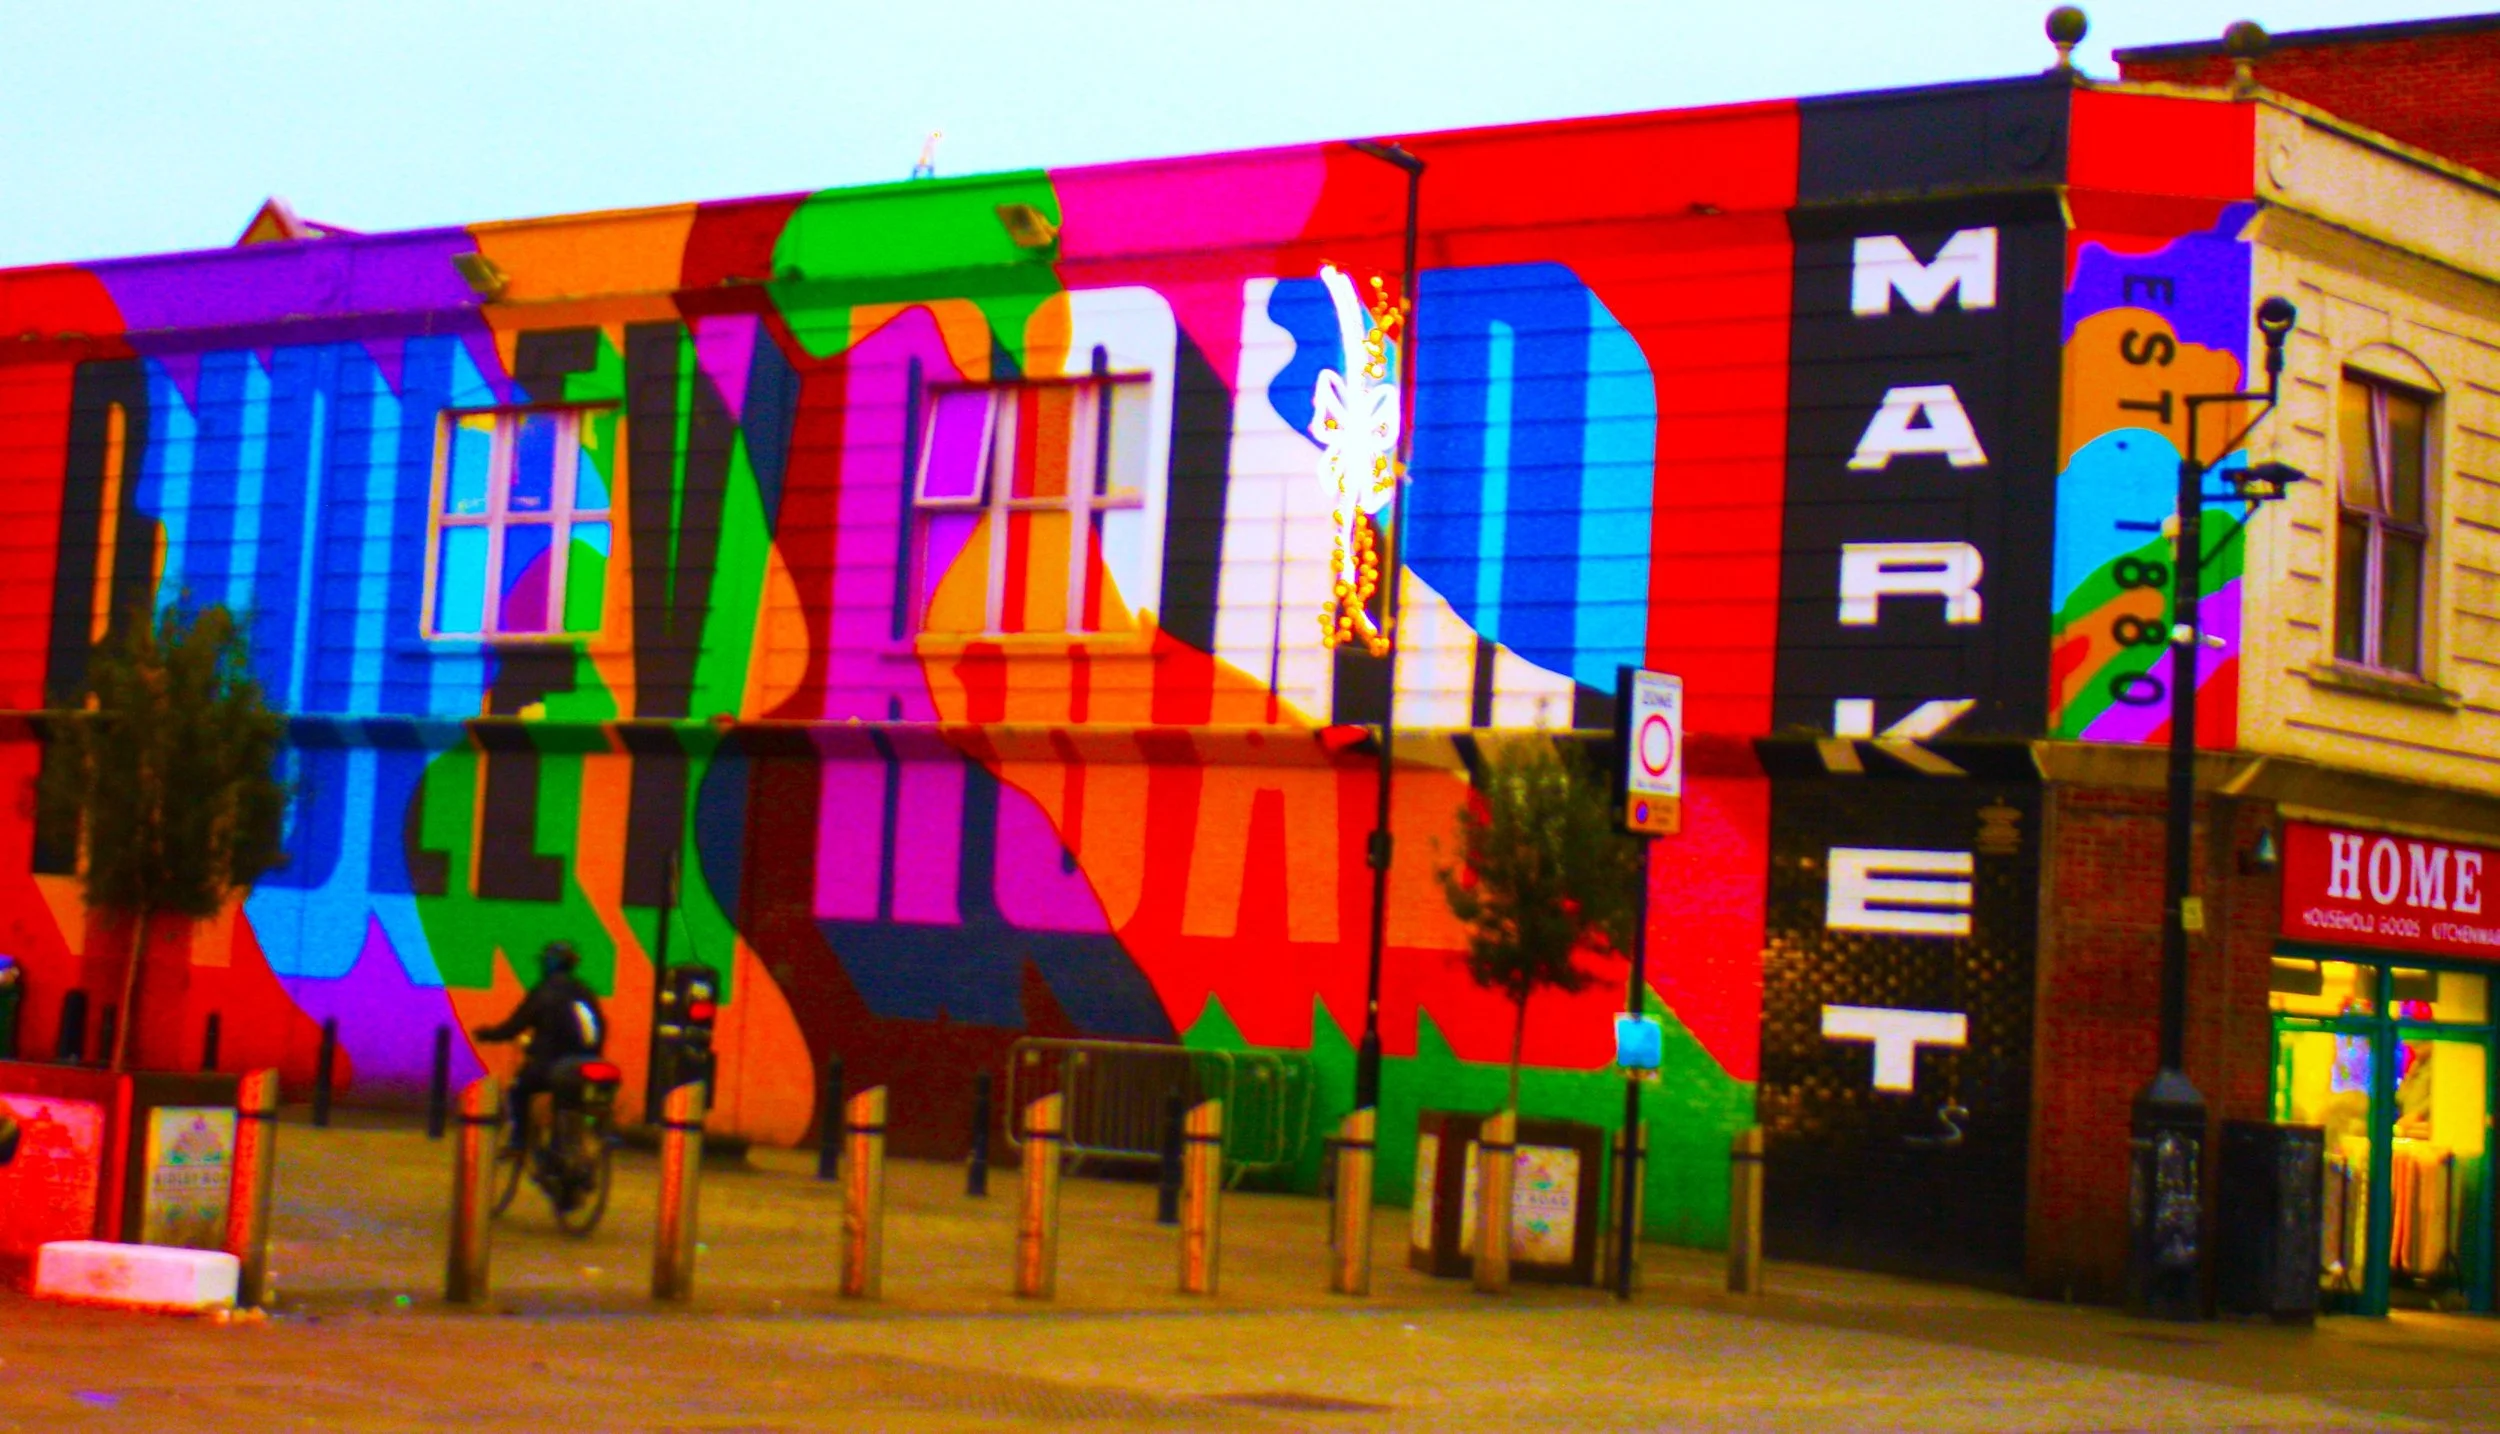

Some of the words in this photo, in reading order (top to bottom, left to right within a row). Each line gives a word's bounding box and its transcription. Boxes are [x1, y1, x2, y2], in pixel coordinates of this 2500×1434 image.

[1820, 226, 1998, 1093] MARKET
[2108, 518, 2168, 707] 1880
[2303, 906, 2375, 934] HOUSEHOLD
[2378, 915, 2421, 938] GOODS
[2326, 831, 2483, 915] HOME
